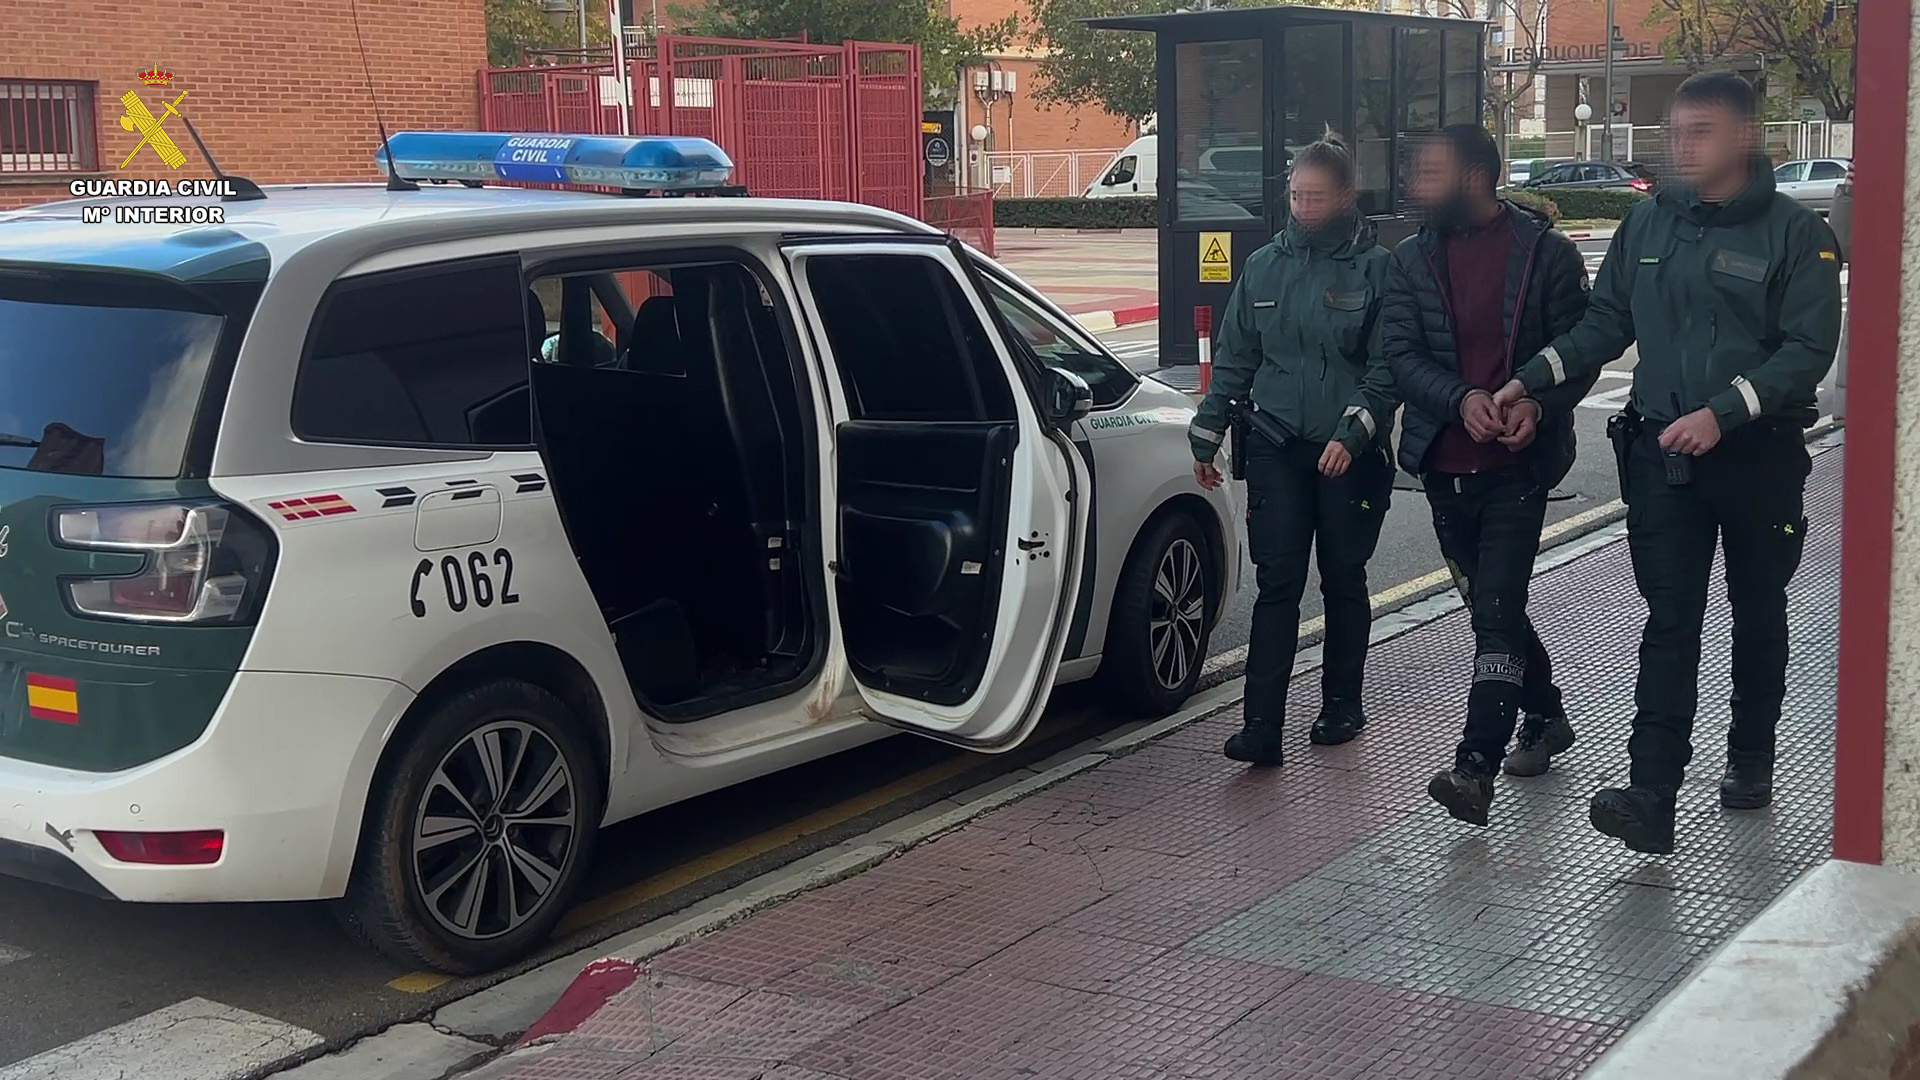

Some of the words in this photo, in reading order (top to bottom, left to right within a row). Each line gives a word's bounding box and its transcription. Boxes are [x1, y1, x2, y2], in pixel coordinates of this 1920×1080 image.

[1506, 46, 1534, 63] IES
[507, 137, 572, 150] GUARDIA
[512, 149, 548, 163] CIVIL
[1090, 414, 1135, 430] GUARDIA
[441, 547, 520, 613] 062
[39, 633, 161, 656] SPACETOURER
